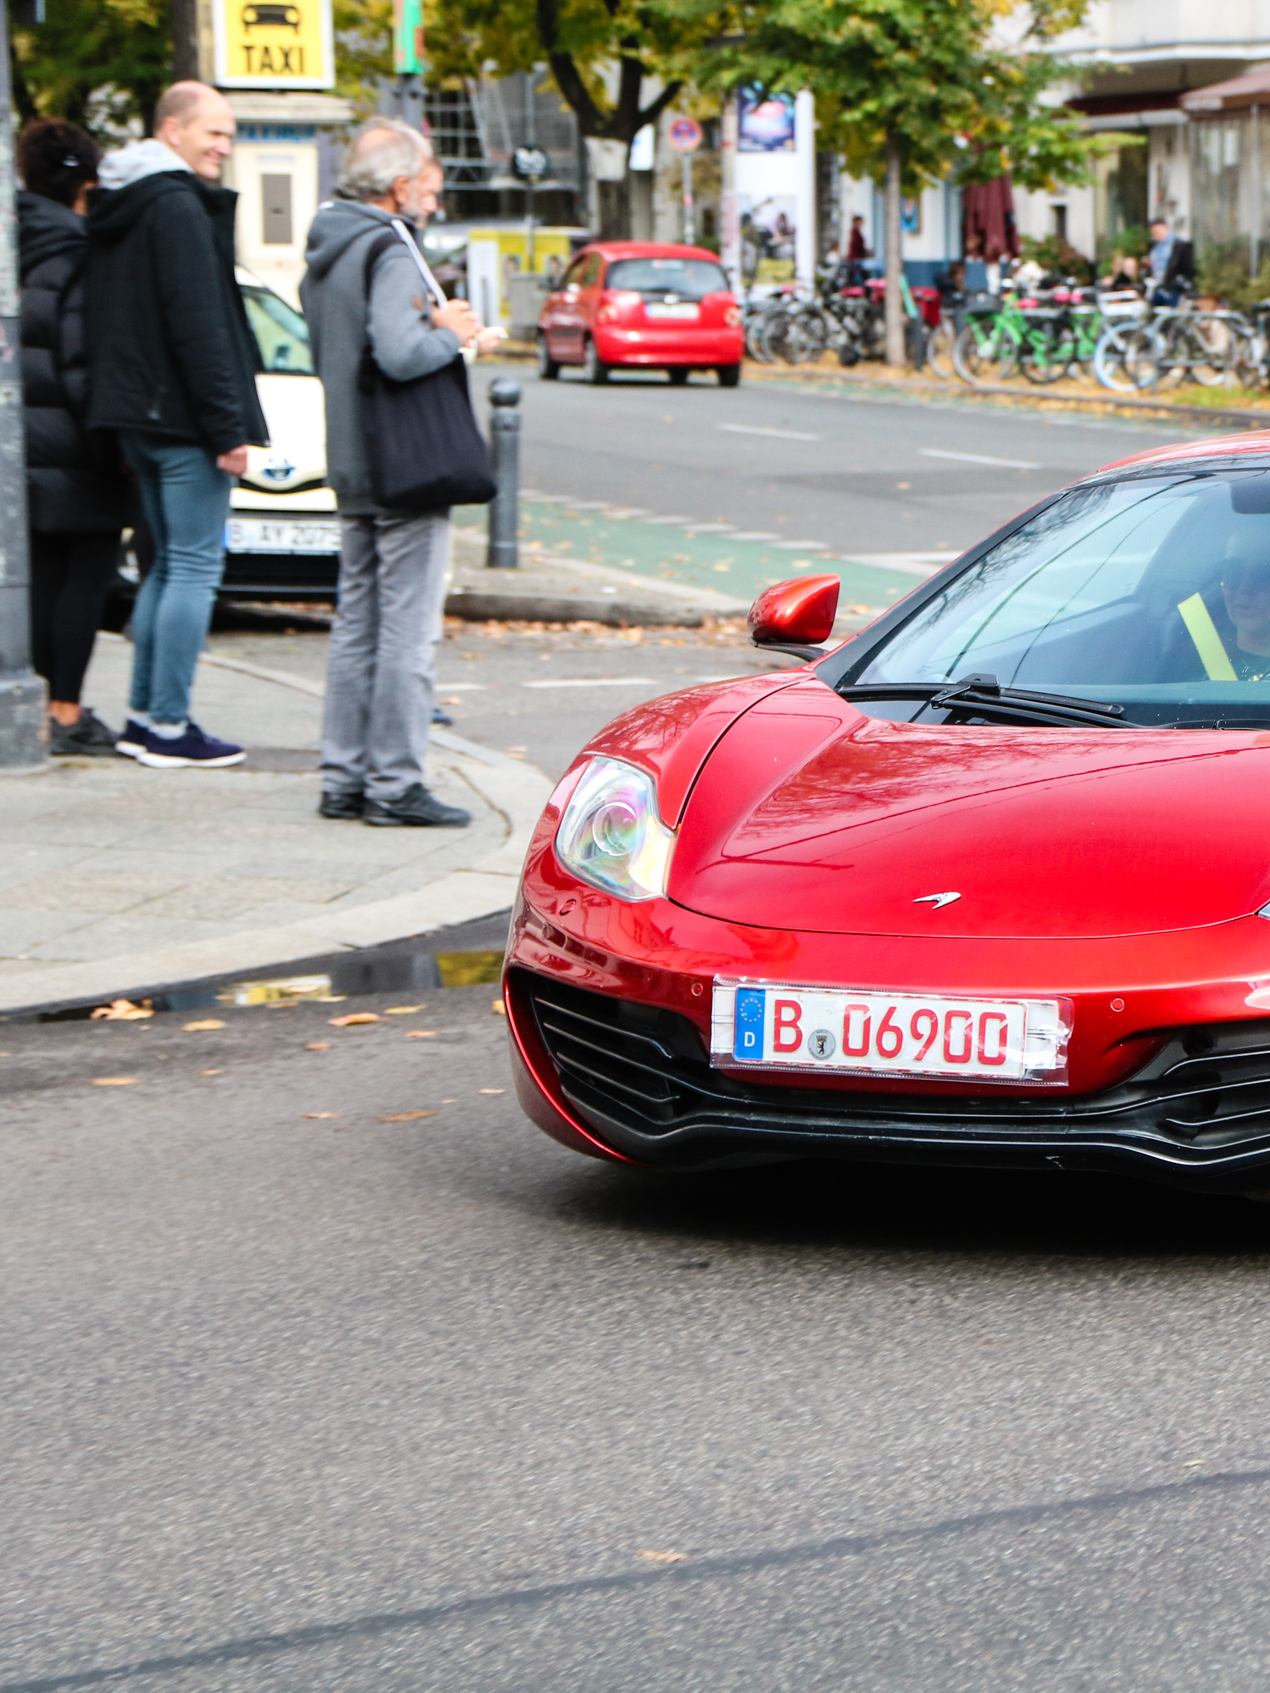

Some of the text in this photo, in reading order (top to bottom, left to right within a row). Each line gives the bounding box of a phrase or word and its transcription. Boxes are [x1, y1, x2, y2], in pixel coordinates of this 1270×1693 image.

[241, 45, 304, 73] TAXI
[744, 1031, 756, 1048] D
[773, 998, 1009, 1067] B 06900
